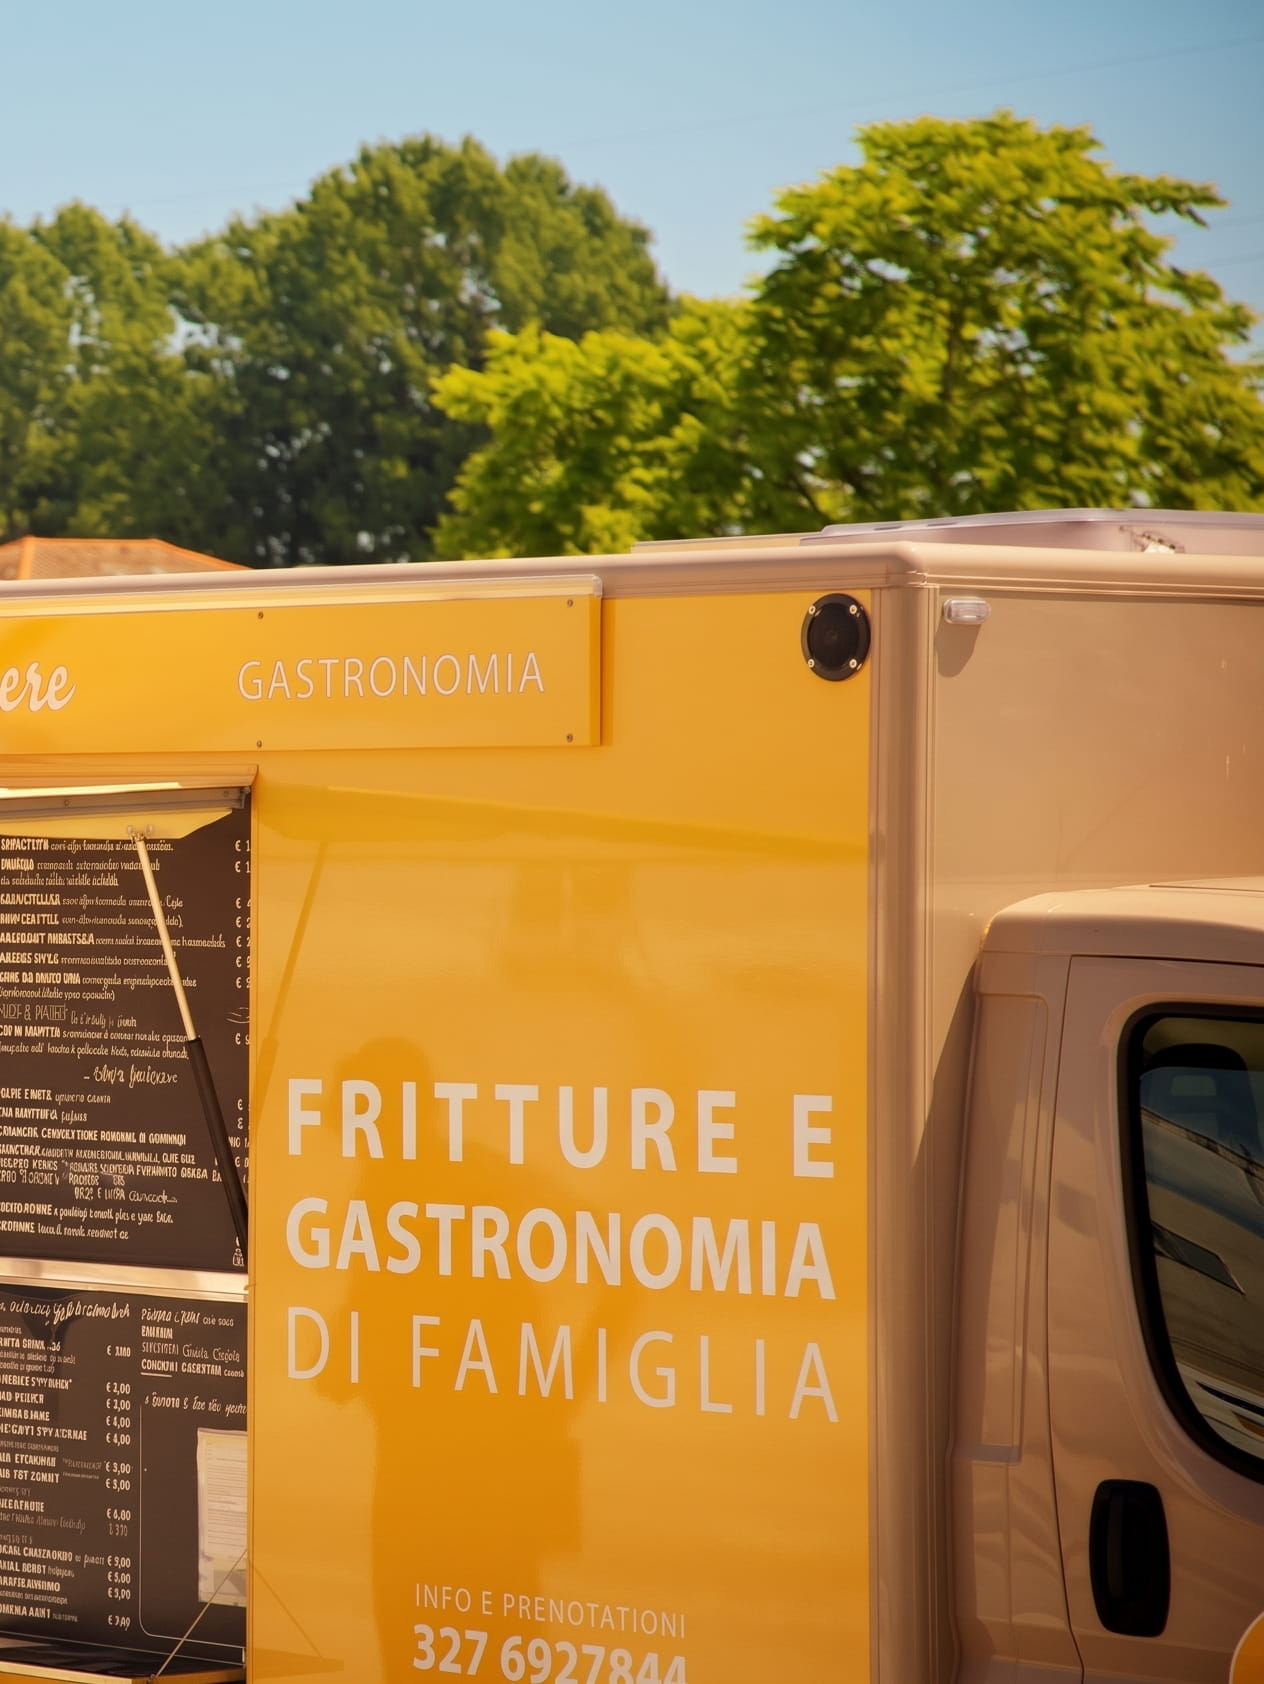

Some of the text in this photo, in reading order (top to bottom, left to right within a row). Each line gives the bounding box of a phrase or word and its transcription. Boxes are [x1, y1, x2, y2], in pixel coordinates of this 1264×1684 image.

[238, 652, 545, 700] GASTRONOMIA
[288, 1078, 834, 1179] FRITTURE E
[286, 1196, 836, 1300] GASTRONOMIA
[288, 1306, 359, 1384] DI
[412, 1314, 839, 1423] FAMIGLIA
[413, 1623, 488, 1676] 327
[415, 1583, 685, 1638] INFO E PRENOTATIONI
